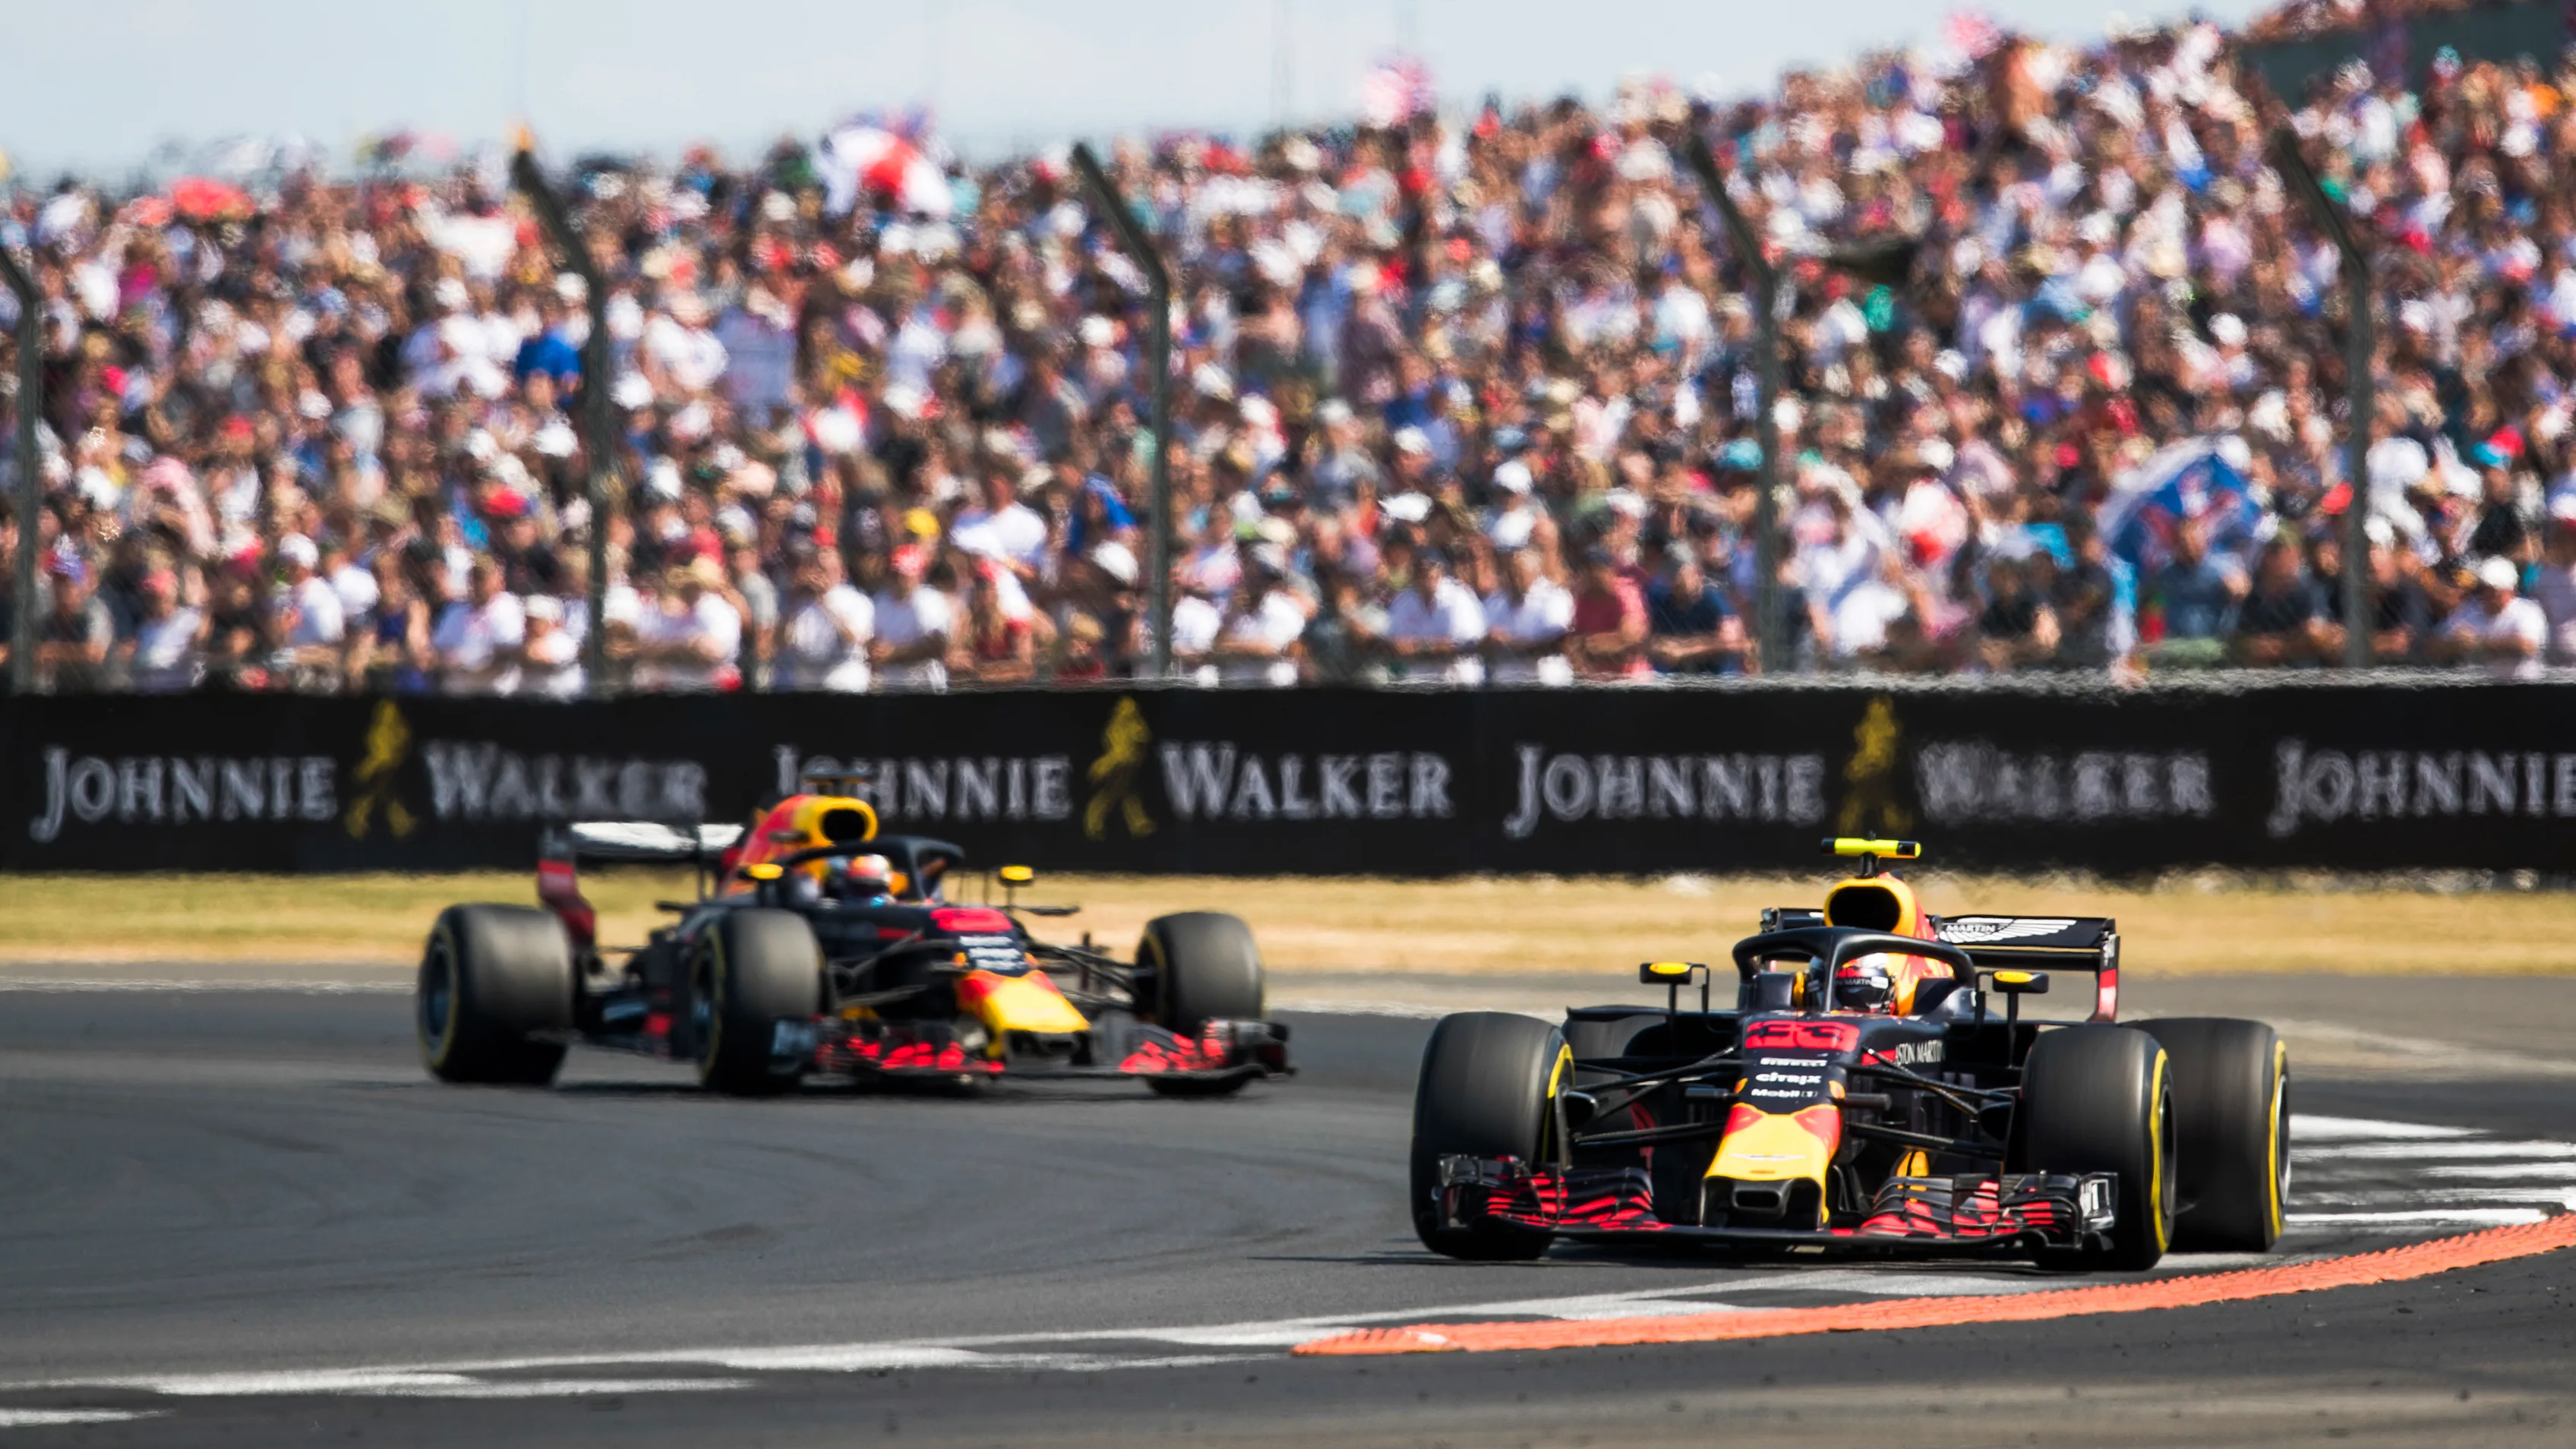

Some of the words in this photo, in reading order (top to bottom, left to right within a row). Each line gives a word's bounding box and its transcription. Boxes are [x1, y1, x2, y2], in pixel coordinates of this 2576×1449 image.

[30, 746, 337, 841] JOHNNIE
[425, 742, 707, 816] WALKER
[1160, 741, 1453, 819] WALKER
[1504, 745, 1821, 839] JOHNNIE
[1751, 1088, 1800, 1098] Mobil
